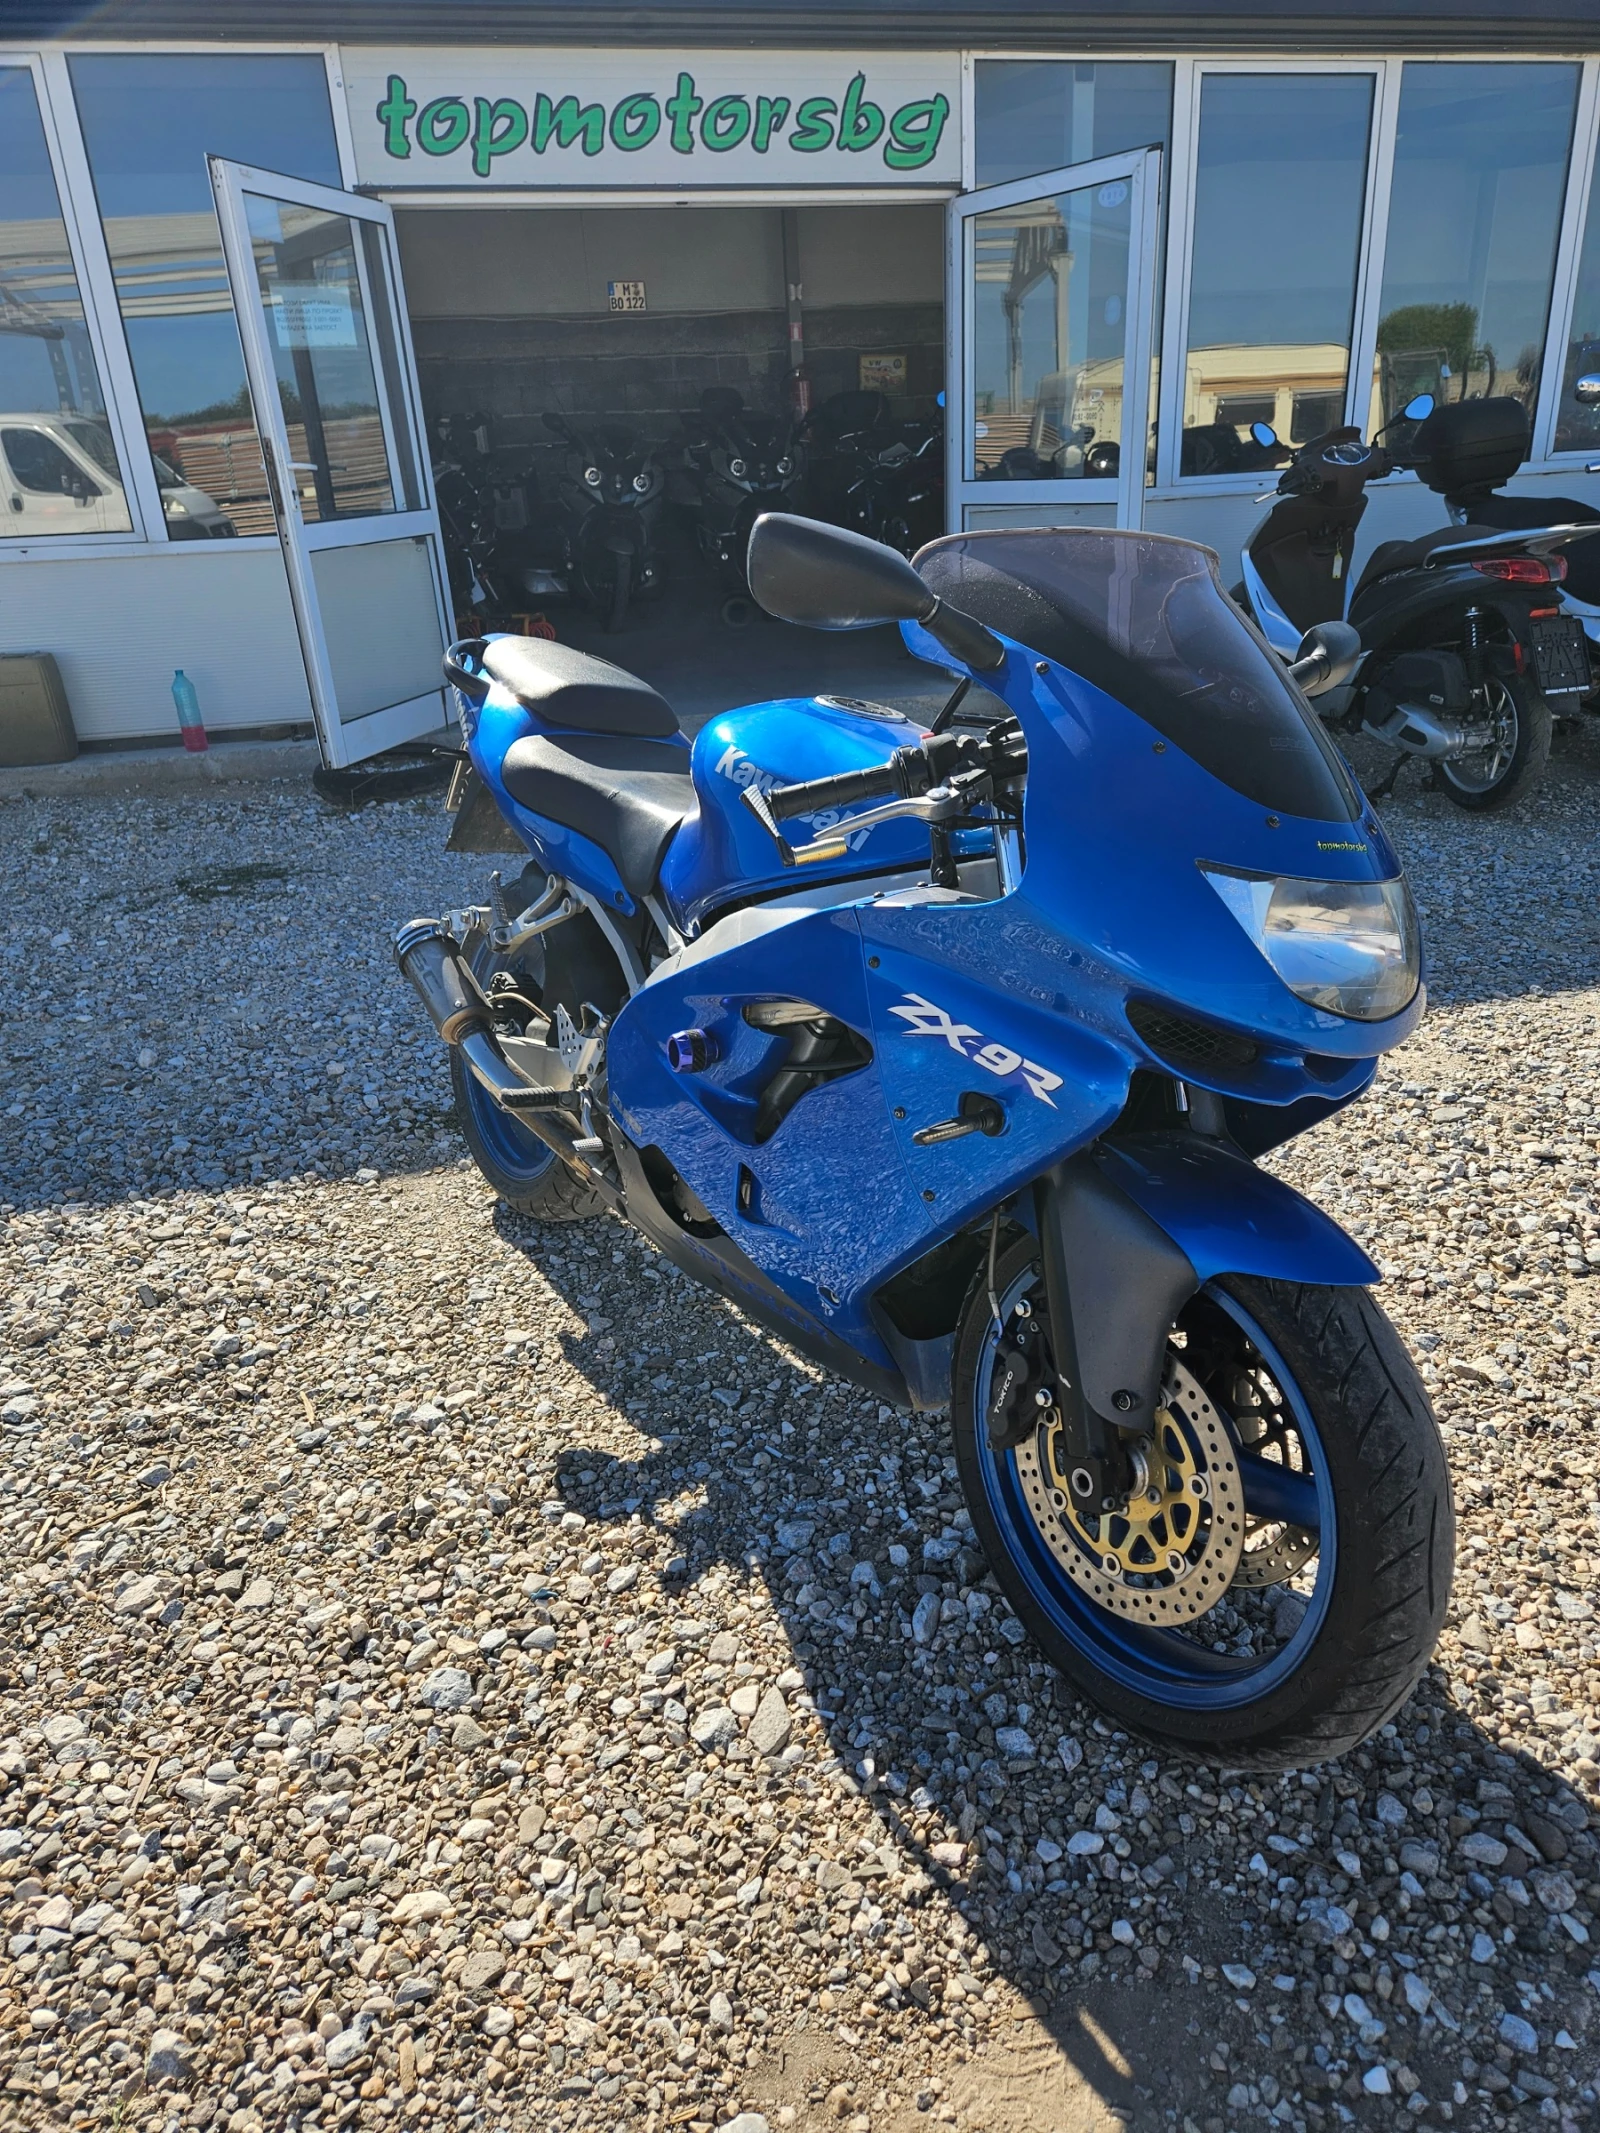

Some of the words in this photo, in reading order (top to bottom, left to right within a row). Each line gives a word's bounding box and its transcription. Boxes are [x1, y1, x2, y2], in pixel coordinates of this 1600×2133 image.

[376, 70, 950, 177] topmotorsbg
[611, 297, 624, 309] BO
[626, 297, 645, 309] 122
[622, 283, 631, 296] M
[887, 993, 1064, 1110] ZX-9R
[993, 1370, 1014, 1413] TOKICO
